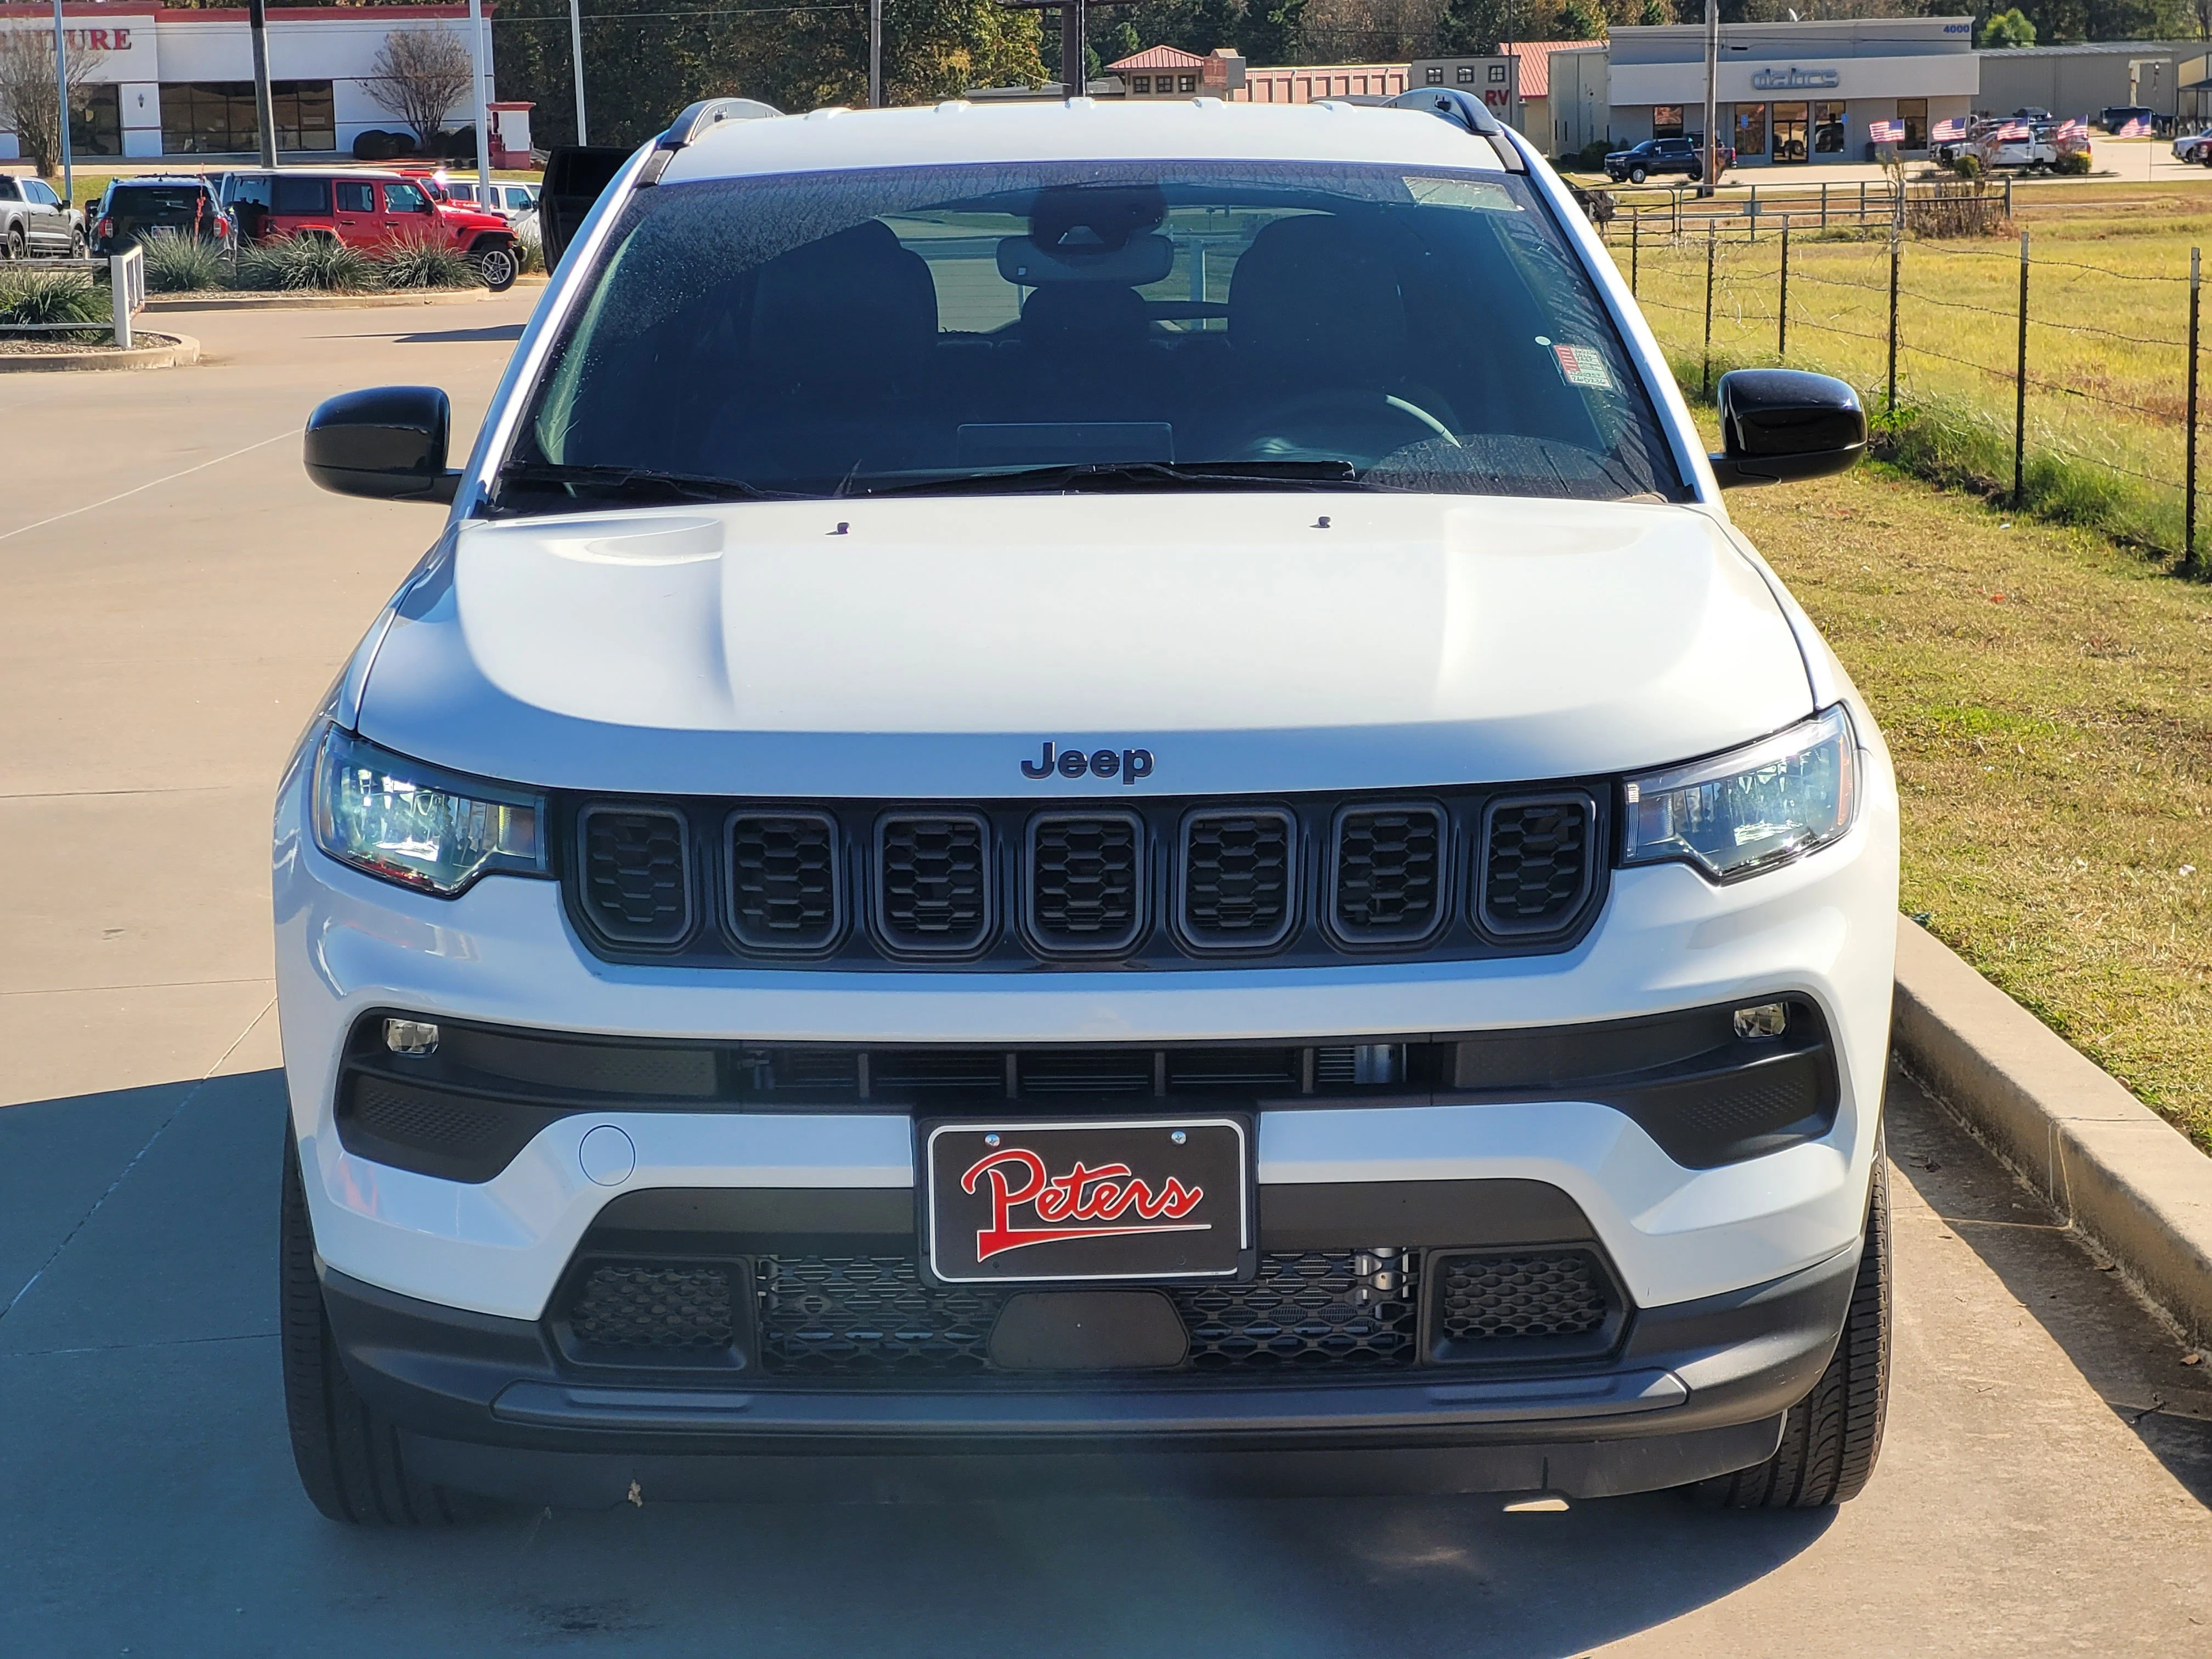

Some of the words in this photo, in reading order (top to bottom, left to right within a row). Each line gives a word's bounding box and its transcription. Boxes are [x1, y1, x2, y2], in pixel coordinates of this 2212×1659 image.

[1943, 25, 1970, 33] 4000
[1485, 89, 1509, 105] RV
[1020, 741, 1154, 785] Jeep
[961, 1148, 1207, 1237] Peters
